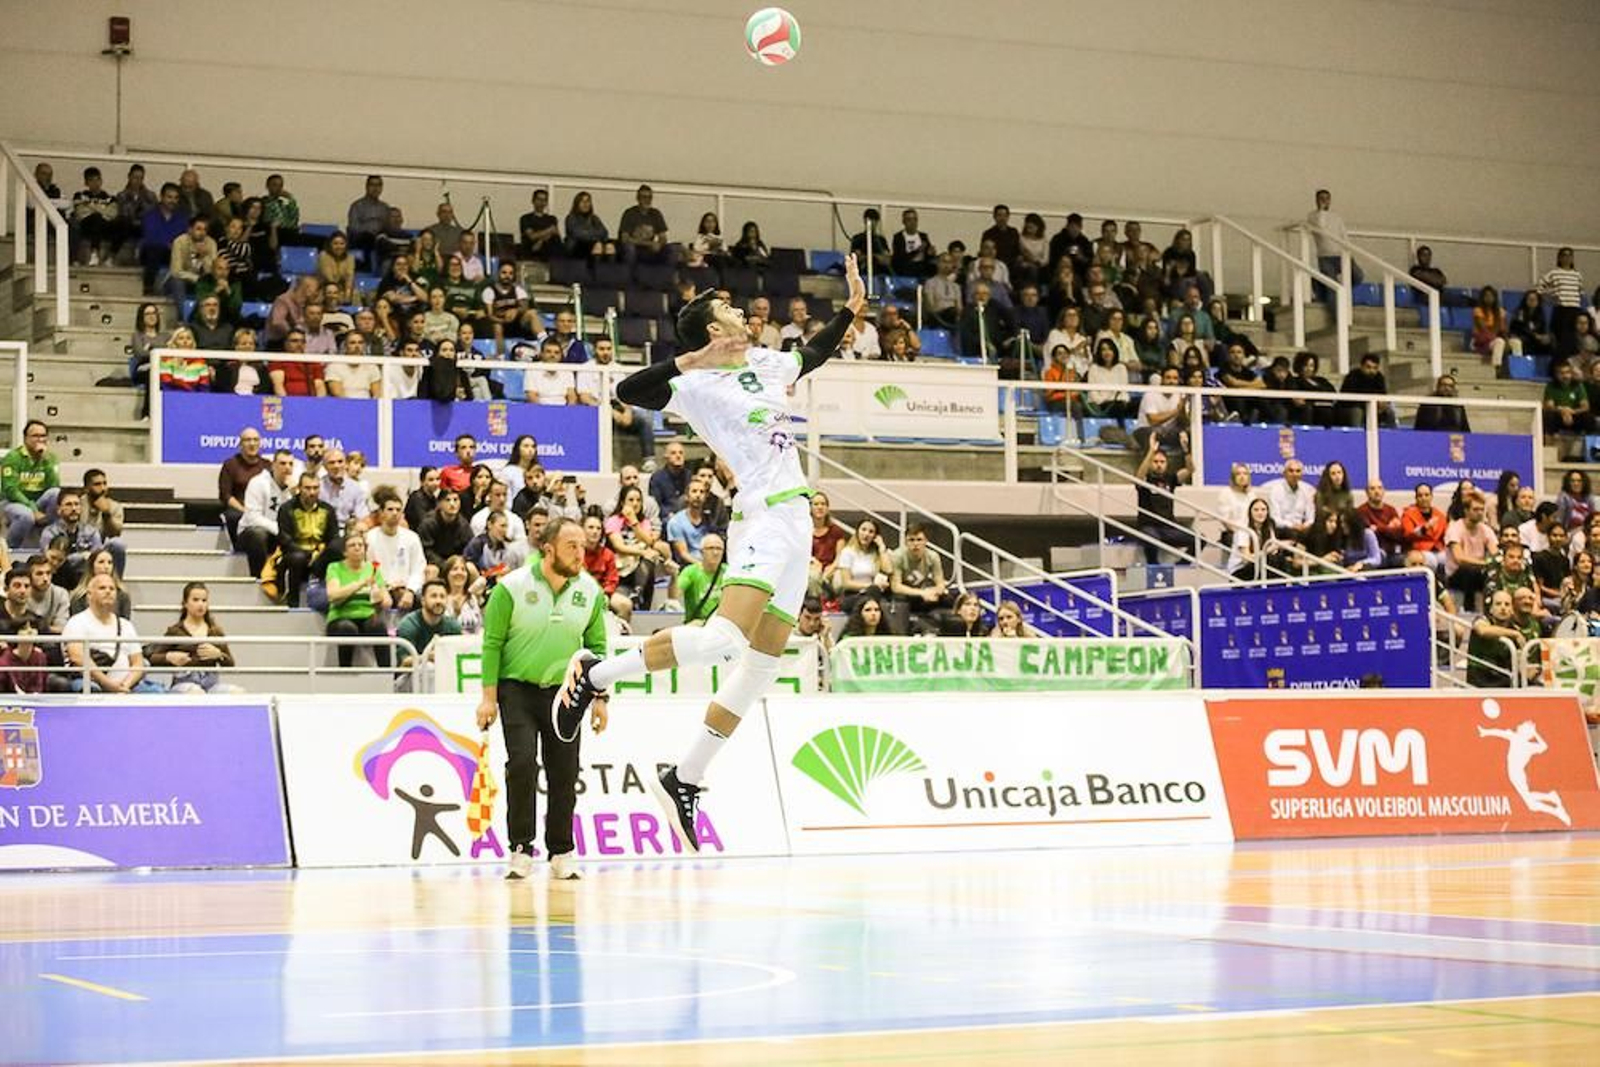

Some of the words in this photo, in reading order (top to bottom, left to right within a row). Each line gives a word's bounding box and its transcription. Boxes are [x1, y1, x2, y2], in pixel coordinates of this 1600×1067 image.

[737, 371, 763, 394] 8
[906, 400, 947, 416] Unicaja
[949, 402, 984, 413] Banco
[1019, 644, 1169, 675] CAMPEON
[1263, 728, 1429, 787] SVM
[924, 771, 1081, 817] Unicaja
[1086, 773, 1206, 805] Banco
[1270, 798, 1353, 819] SUPERLIGA
[1355, 796, 1426, 818] VOLEIBOL
[1428, 796, 1512, 816] MASCULINA
[28, 805, 67, 827] DE
[75, 797, 201, 827] ALMERÍA
